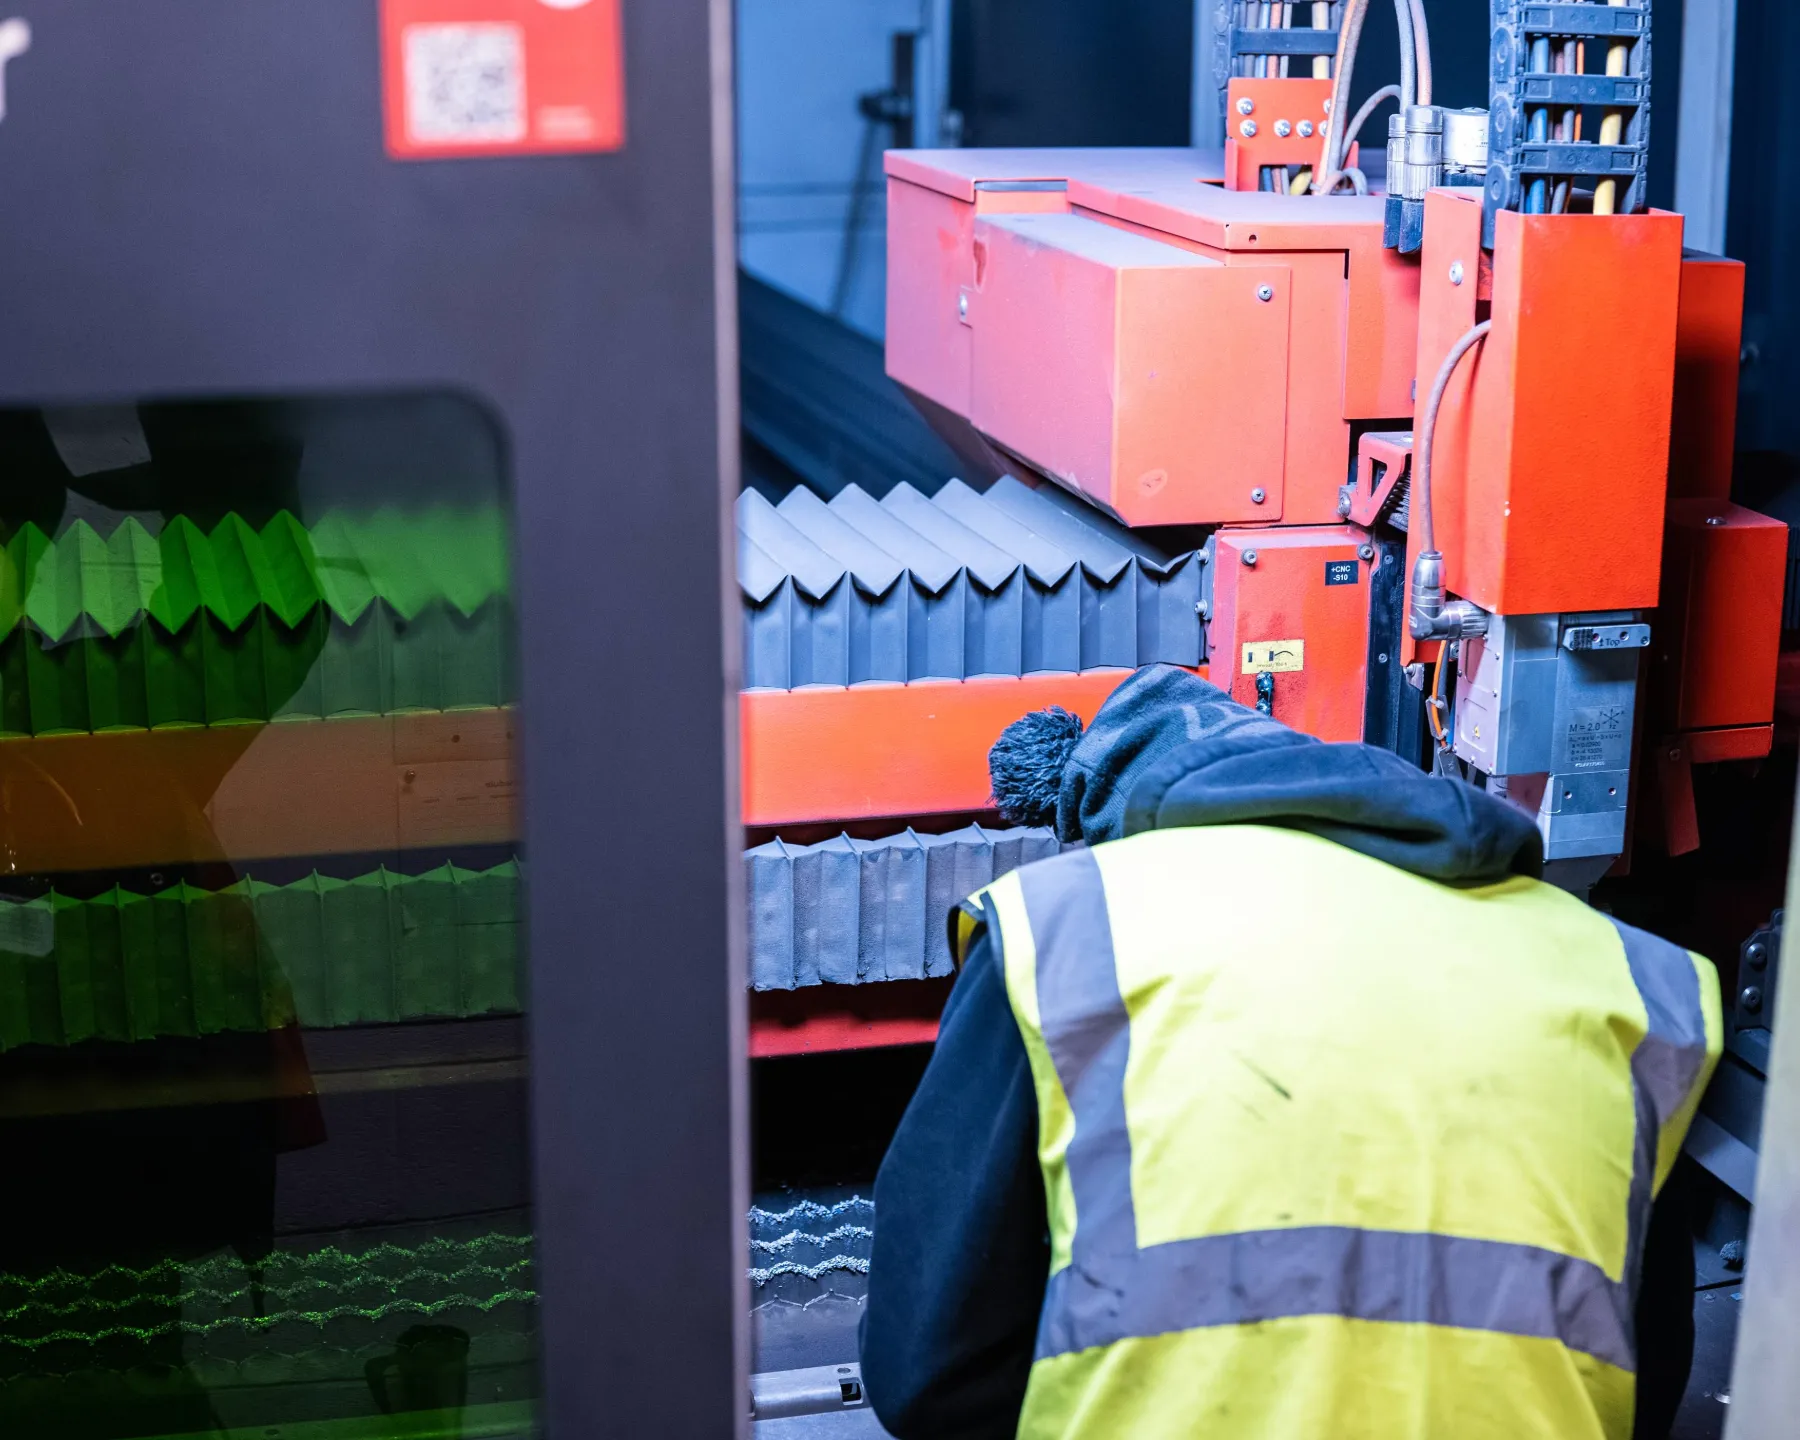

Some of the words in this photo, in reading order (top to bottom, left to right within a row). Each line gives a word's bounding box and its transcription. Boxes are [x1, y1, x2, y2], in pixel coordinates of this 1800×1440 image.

[1331, 565, 1350, 573] +CNC
[1605, 638, 1620, 647] Top
[1569, 723, 1578, 732] M
[1587, 722, 1600, 732] 2.0
